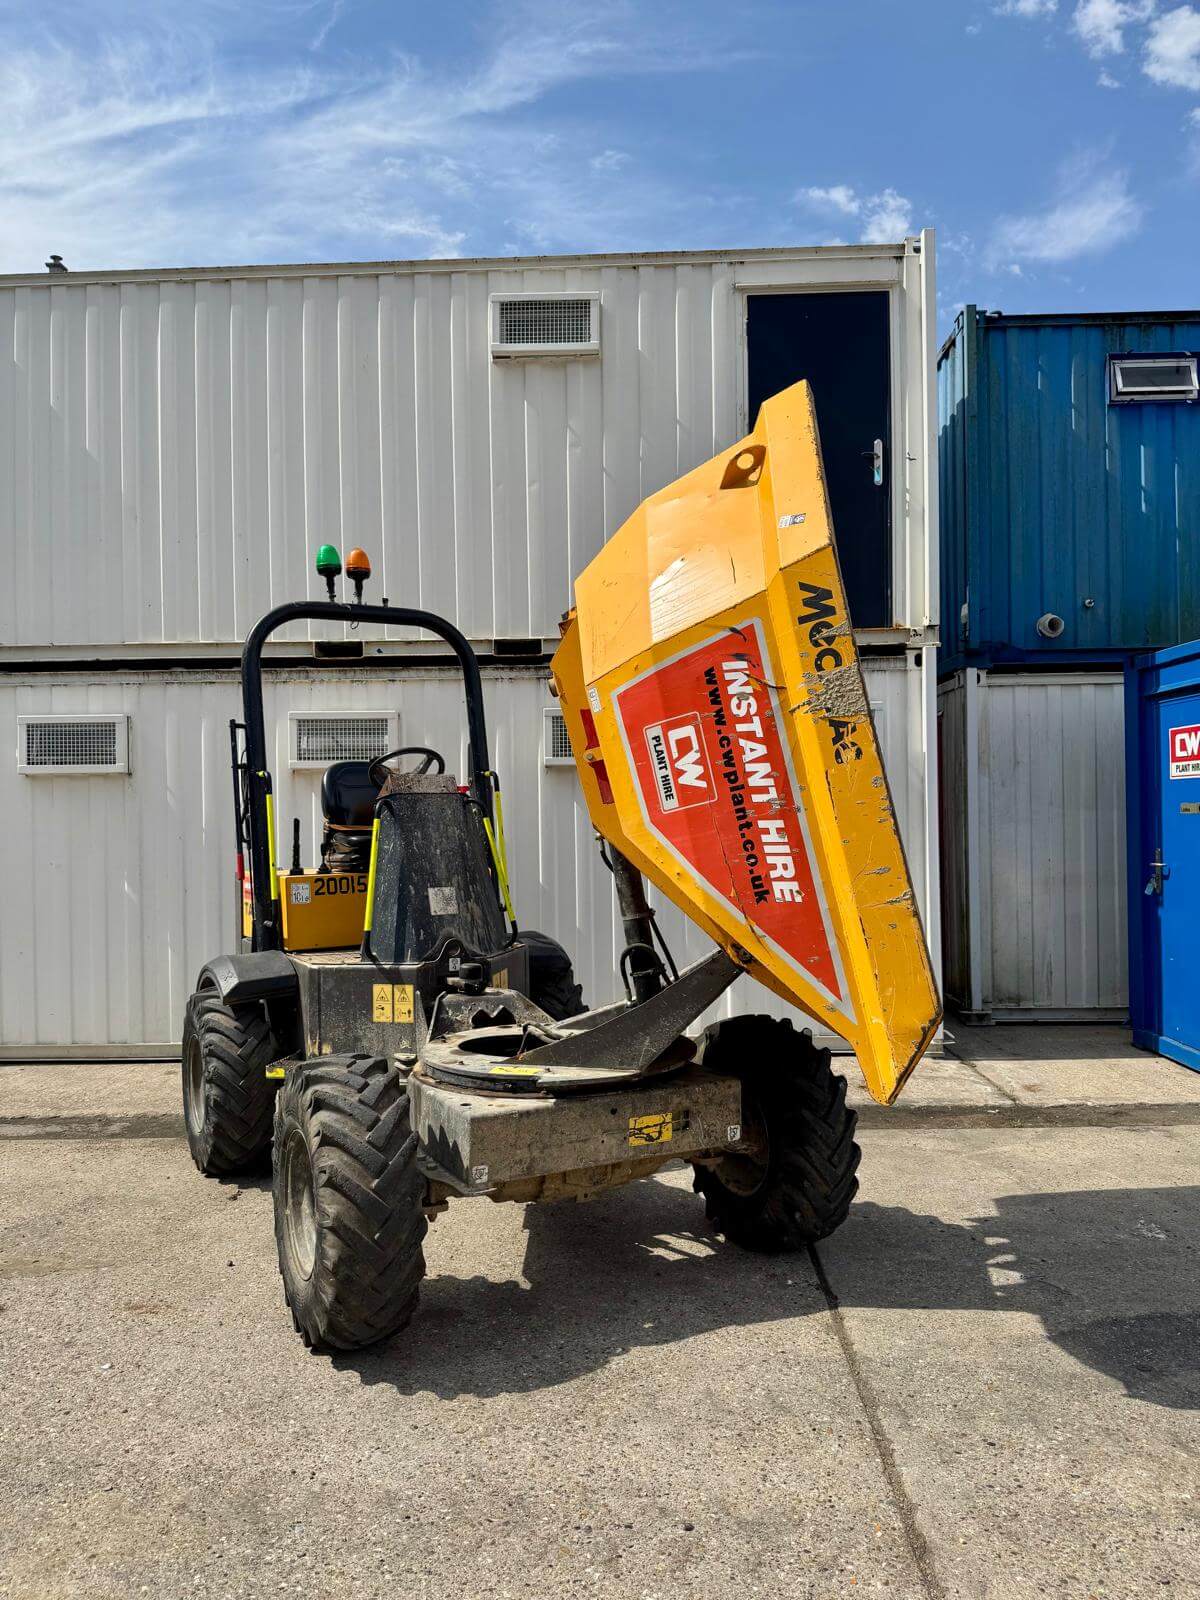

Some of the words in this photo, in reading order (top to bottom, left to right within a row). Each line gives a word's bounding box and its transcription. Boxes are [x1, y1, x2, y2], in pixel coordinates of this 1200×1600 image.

[651, 734, 671, 774] PLANT
[662, 773, 676, 802] HIRE
[668, 724, 708, 789] CW
[1175, 731, 1200, 757] CW
[1176, 764, 1191, 773] PLANT
[1191, 762, 1200, 772] HIR
[703, 666, 769, 905] www.cwplant.co.uk
[721, 660, 778, 804] INSTANT
[757, 819, 804, 904] HIRE
